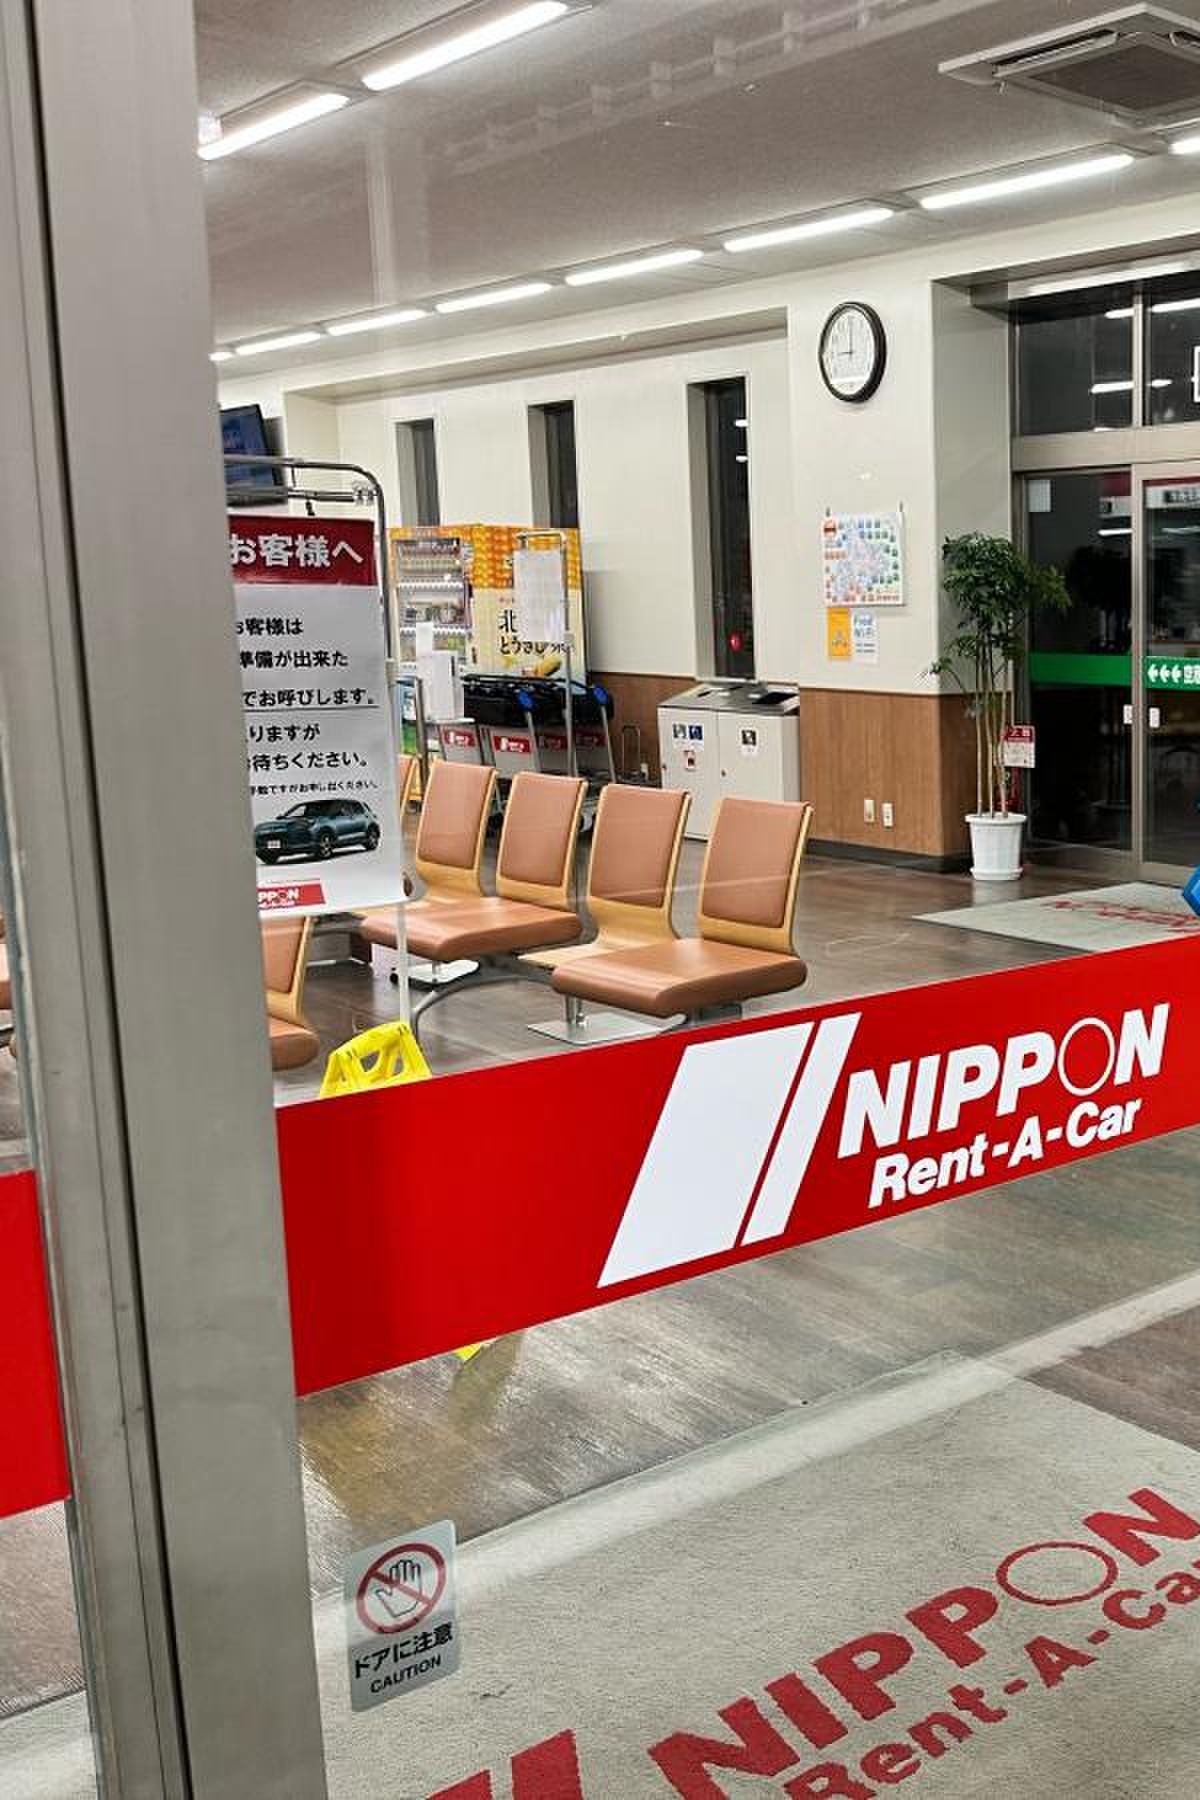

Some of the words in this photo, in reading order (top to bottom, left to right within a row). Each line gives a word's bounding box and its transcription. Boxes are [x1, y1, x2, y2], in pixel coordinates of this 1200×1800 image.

[231, 533, 364, 567] お客様へ
[240, 650, 349, 668] 準備が出来た
[243, 687, 375, 706] でお呼びします。
[246, 723, 321, 743] りますが
[838, 1003, 1170, 1160] NIPPON
[868, 1098, 1142, 1208] Rent-A-Car
[354, 1621, 453, 1679] ドアに注意
[370, 1653, 442, 1693] CAUTION
